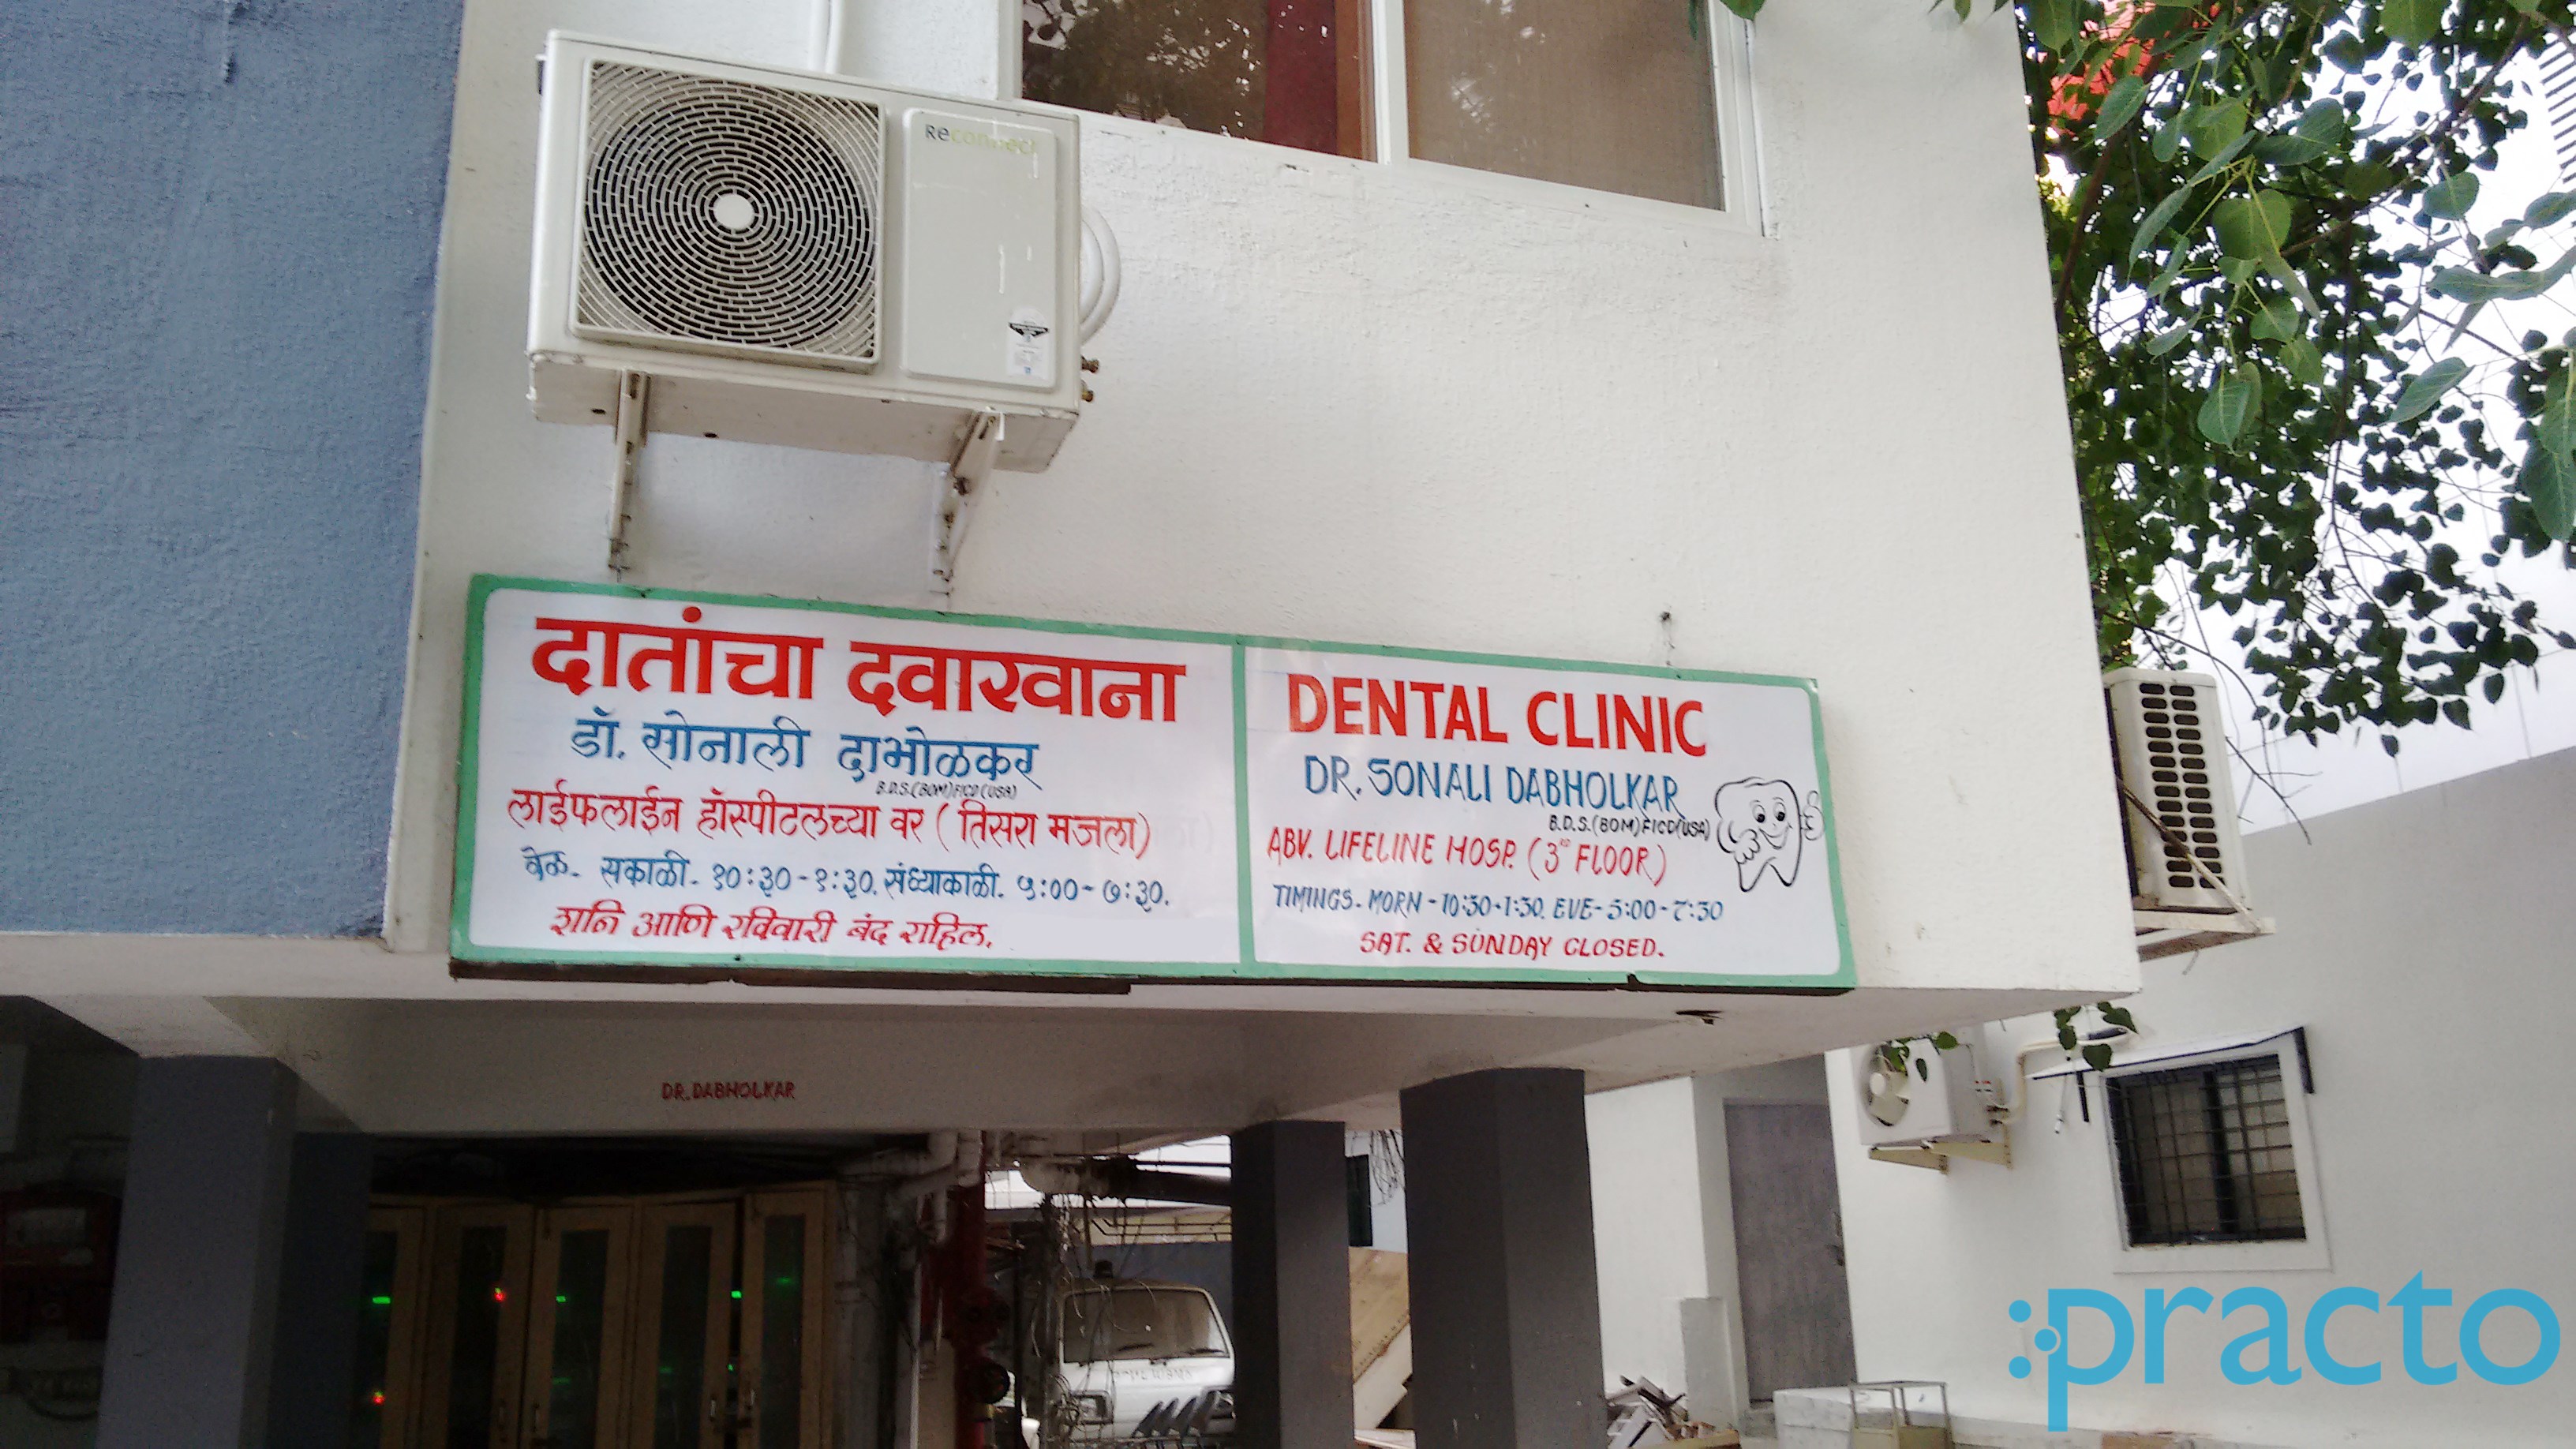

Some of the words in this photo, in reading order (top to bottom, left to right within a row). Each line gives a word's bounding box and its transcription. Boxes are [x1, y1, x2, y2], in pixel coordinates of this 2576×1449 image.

[531, 605, 826, 700] दातांचा
[847, 641, 1187, 722] दवाखाना
[1288, 673, 1509, 743] DENTAL
[1526, 691, 1707, 757] CLINIC
[640, 708, 812, 769] सोनाली
[837, 726, 1042, 790] दाभोळकर
[507, 779, 683, 835] लाईफलाईन
[697, 788, 882, 839] हॉस्पीटलच्या
[890, 808, 925, 843] वर
[1507, 766, 1686, 819] DABHOLKAR
[1325, 830, 1435, 864] LIFELINE
[632, 904, 718, 938] आणि
[723, 907, 837, 942] रविवारी
[848, 914, 893, 945] बंद
[1423, 933, 1443, 955] &
[1452, 934, 1552, 960] SUNDAY
